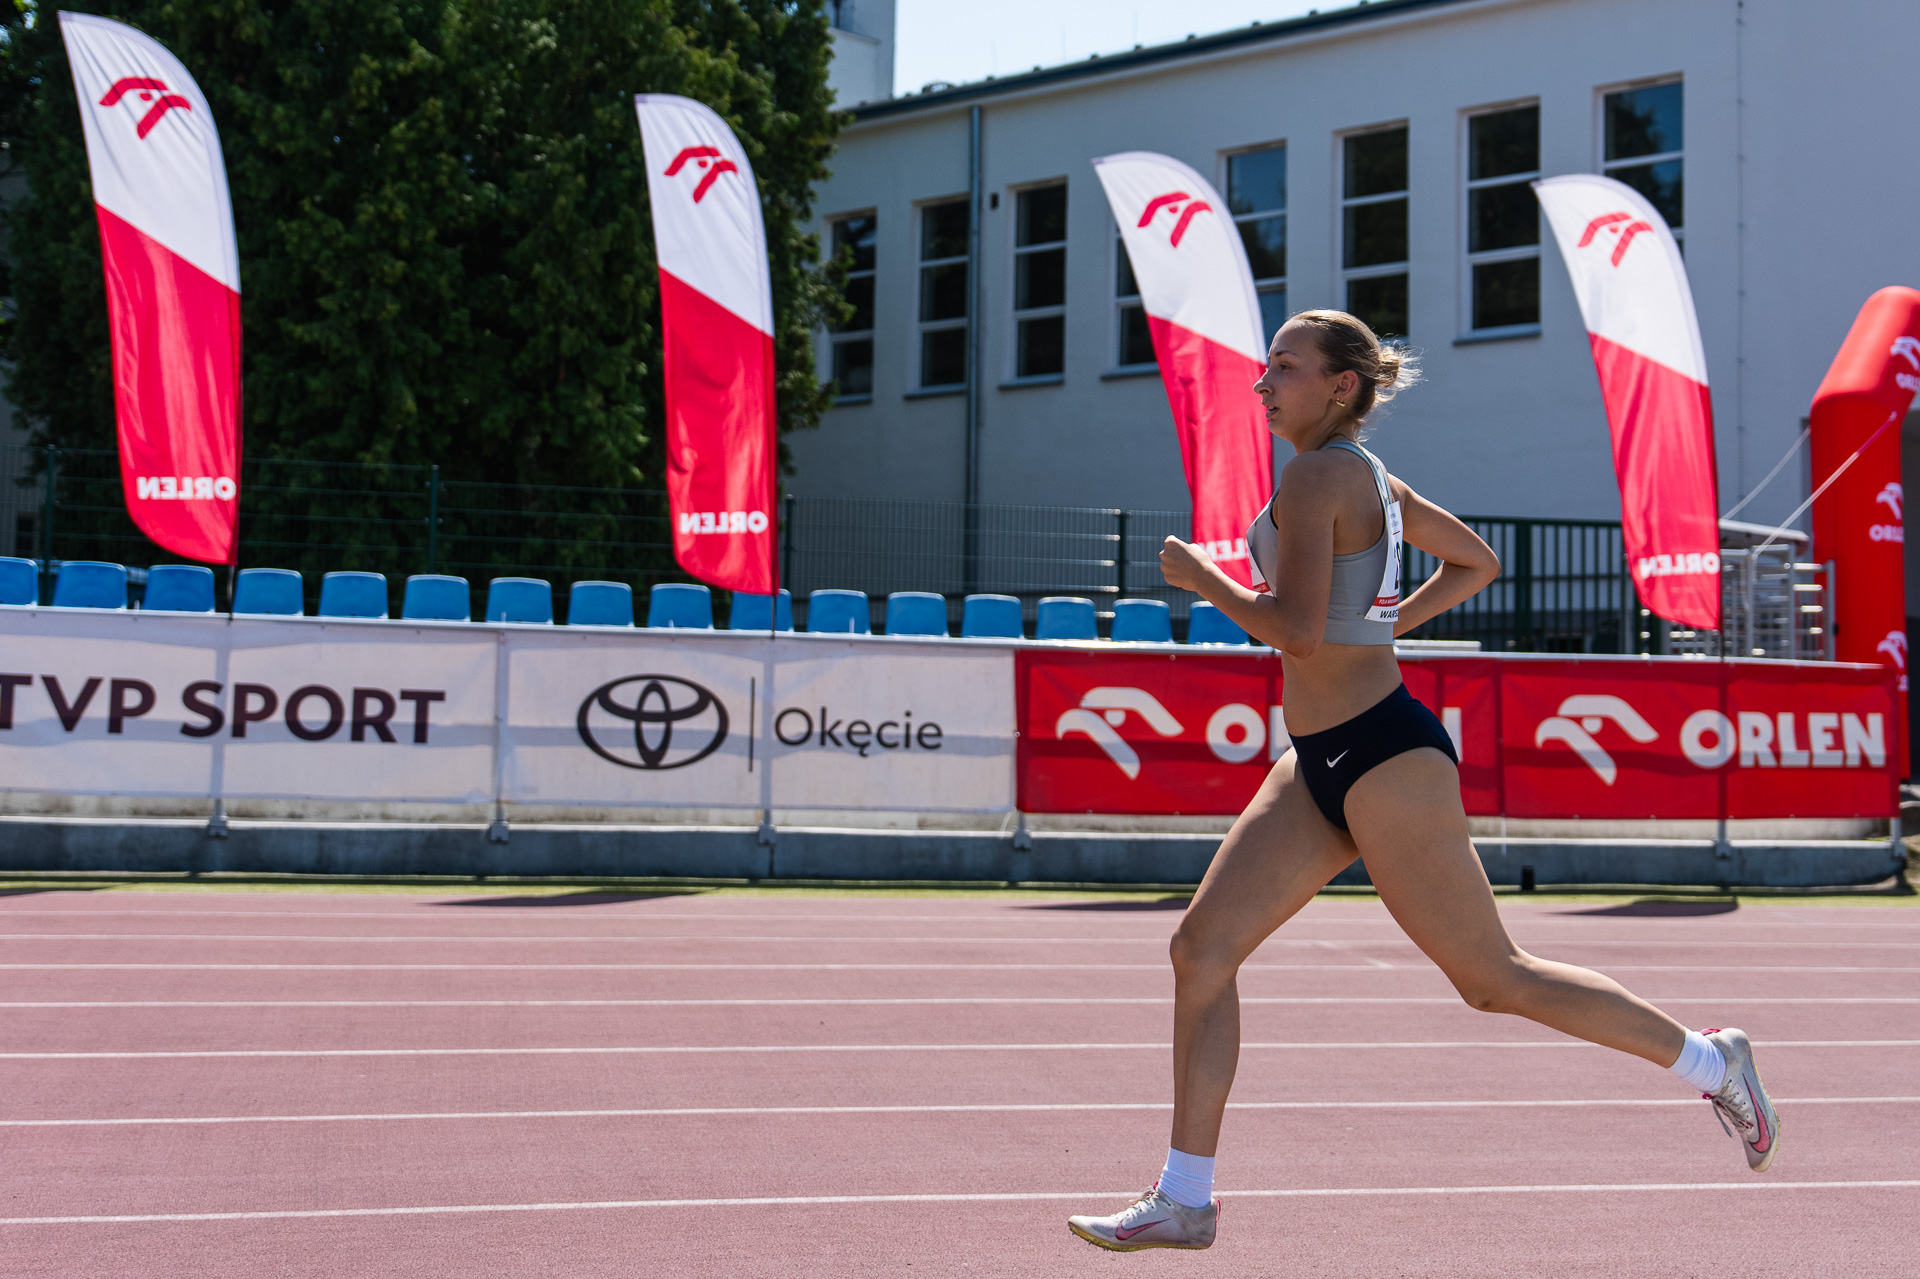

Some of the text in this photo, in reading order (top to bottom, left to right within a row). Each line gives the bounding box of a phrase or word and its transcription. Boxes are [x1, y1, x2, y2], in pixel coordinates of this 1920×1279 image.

[0, 673, 446, 744] TVP SPORT
[774, 706, 943, 757] Okęcie
[1679, 709, 1886, 768] ORLEN
